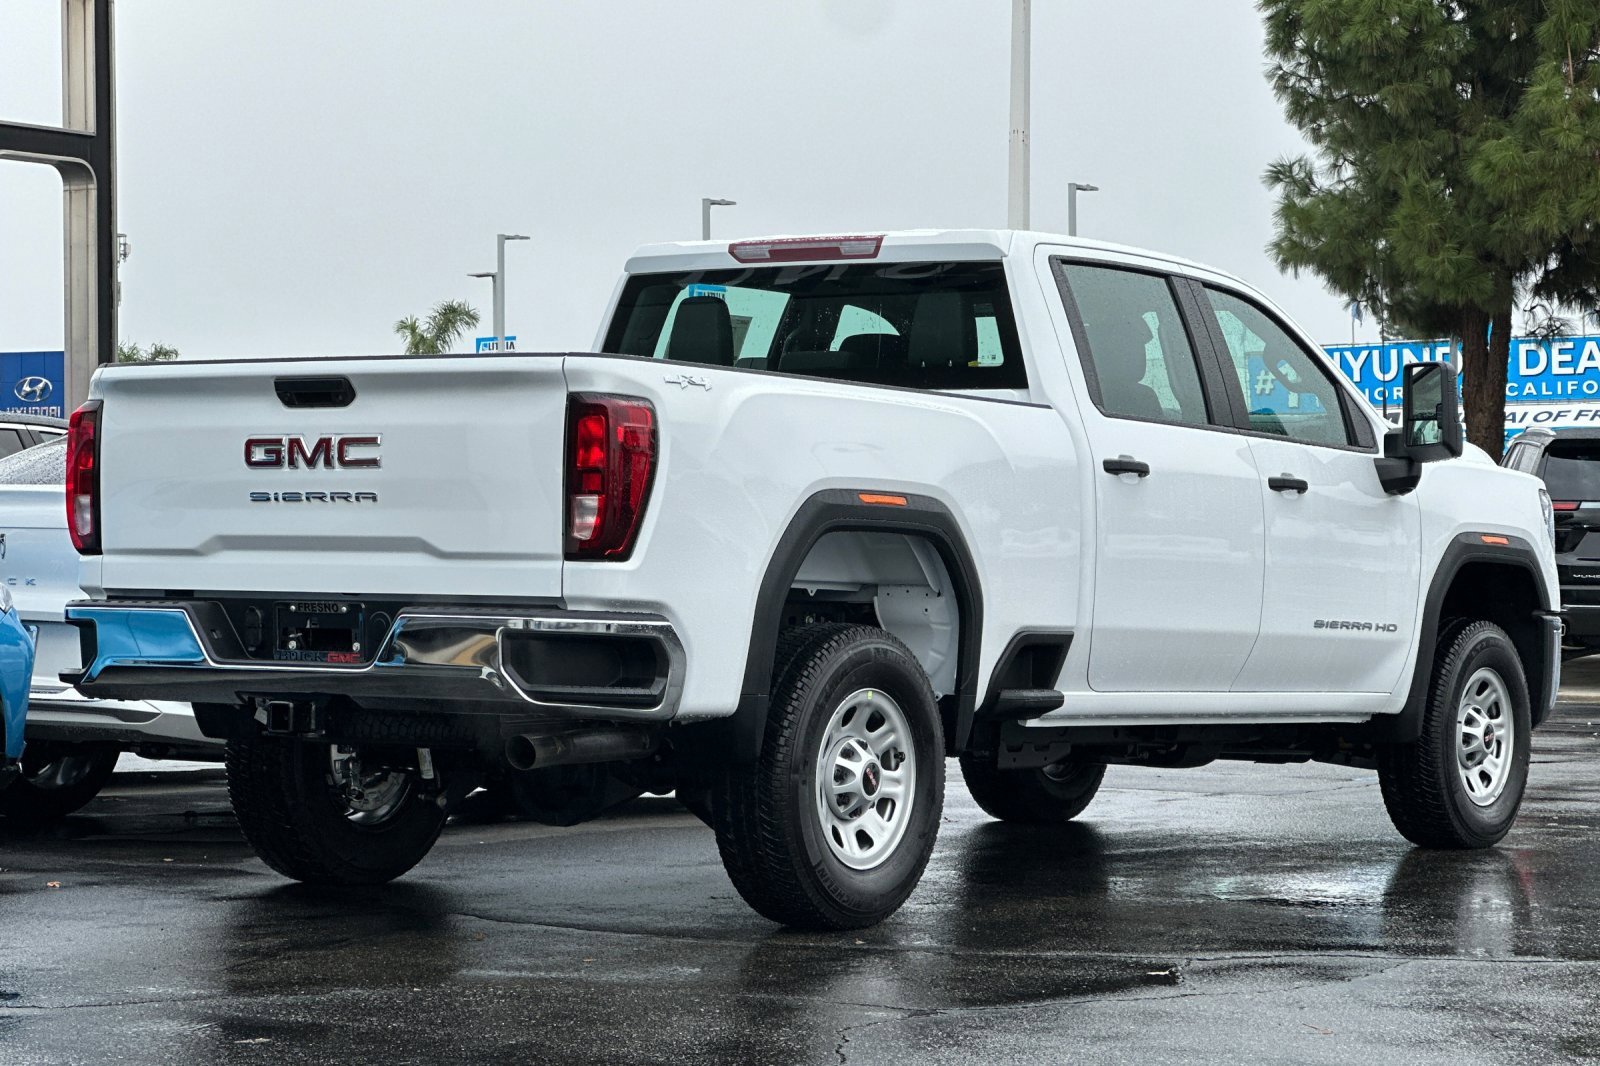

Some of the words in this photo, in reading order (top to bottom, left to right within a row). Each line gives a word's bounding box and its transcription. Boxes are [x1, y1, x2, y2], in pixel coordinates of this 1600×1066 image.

[1532, 410, 1572, 423] OF
[244, 434, 383, 470] GMC
[249, 492, 378, 502] SIERRA
[297, 602, 339, 613] FRESNO
[1313, 619, 1373, 631] SIERRA
[1374, 622, 1398, 633] HD
[327, 652, 361, 664] GMC
